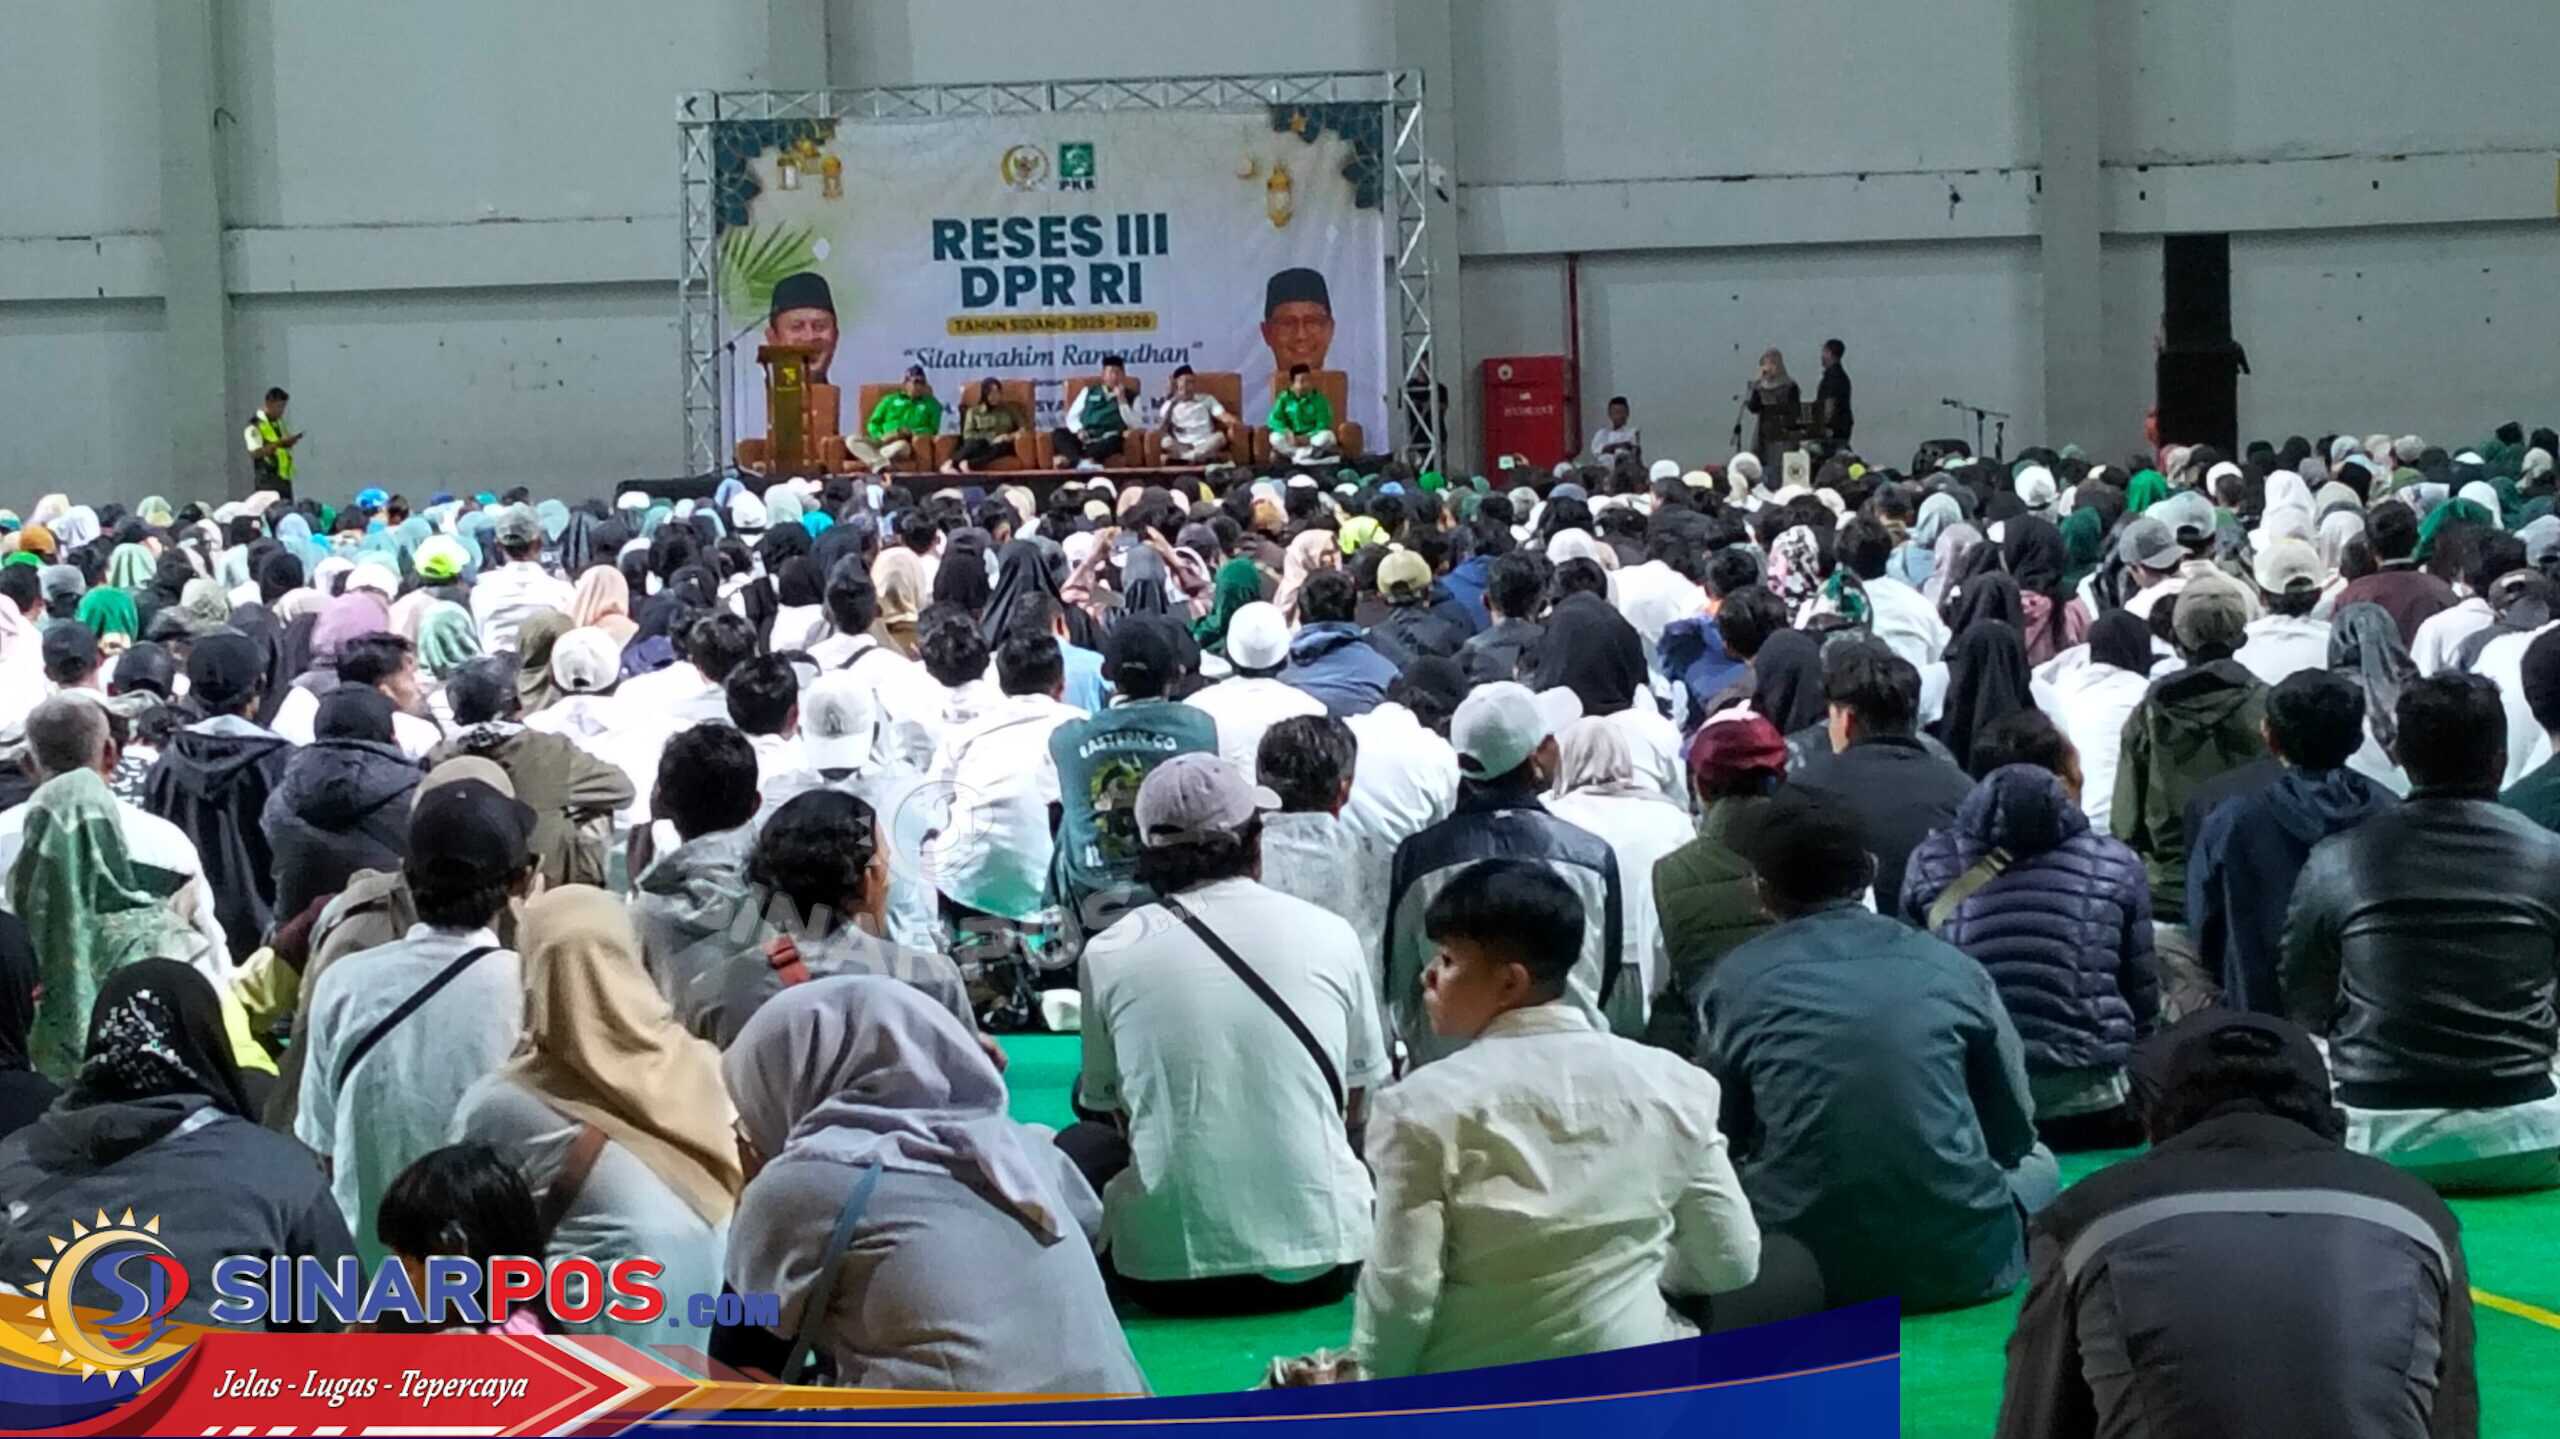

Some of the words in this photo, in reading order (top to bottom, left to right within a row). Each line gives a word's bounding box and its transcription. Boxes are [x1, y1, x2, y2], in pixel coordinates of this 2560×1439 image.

[932, 214, 1104, 260] RESES
[1116, 213, 1169, 256] III
[960, 263, 1076, 308] DPR
[1089, 262, 1142, 305] RI
[955, 319, 1008, 332] TAHUN
[1010, 317, 1067, 331] SIDANG
